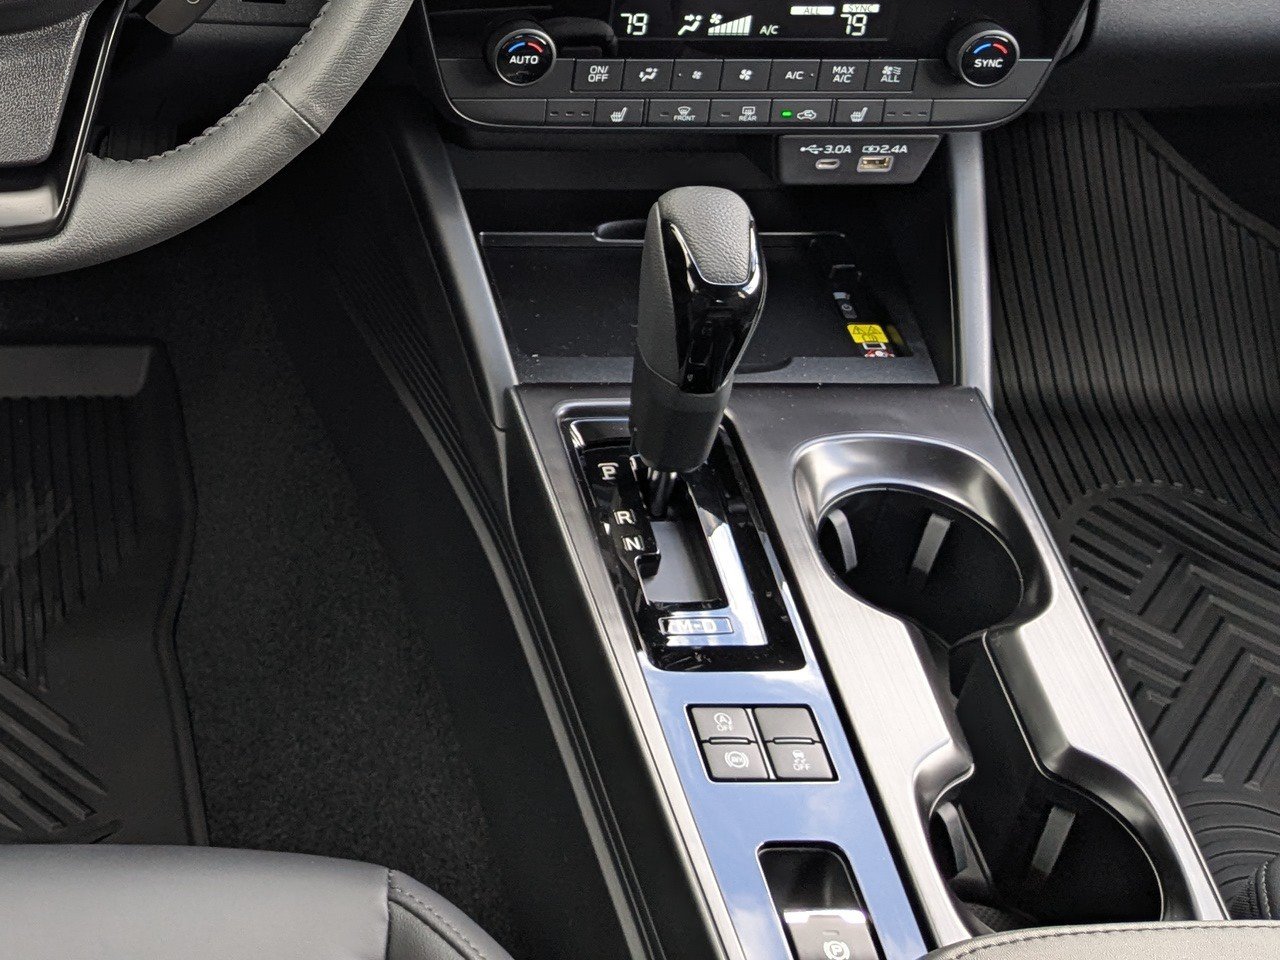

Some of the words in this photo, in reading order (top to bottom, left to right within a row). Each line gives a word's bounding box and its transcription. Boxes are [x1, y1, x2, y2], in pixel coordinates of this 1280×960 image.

[848, 4, 874, 13] SYNC
[620, 12, 649, 36] 79
[840, 13, 868, 36] 79
[759, 25, 779, 36] A/C
[509, 55, 539, 65] AUTO
[973, 58, 1004, 68] SYNC
[589, 65, 609, 74] ON/
[832, 66, 855, 74] MAX
[587, 73, 609, 82] OFF
[785, 70, 804, 80] A/C
[832, 74, 852, 83] A/C
[880, 74, 900, 83] ALL
[738, 114, 757, 122] REAR
[824, 144, 852, 154] 3.0A
[880, 144, 908, 154] 2.4A
[616, 511, 635, 525] R
[623, 536, 644, 551] N
